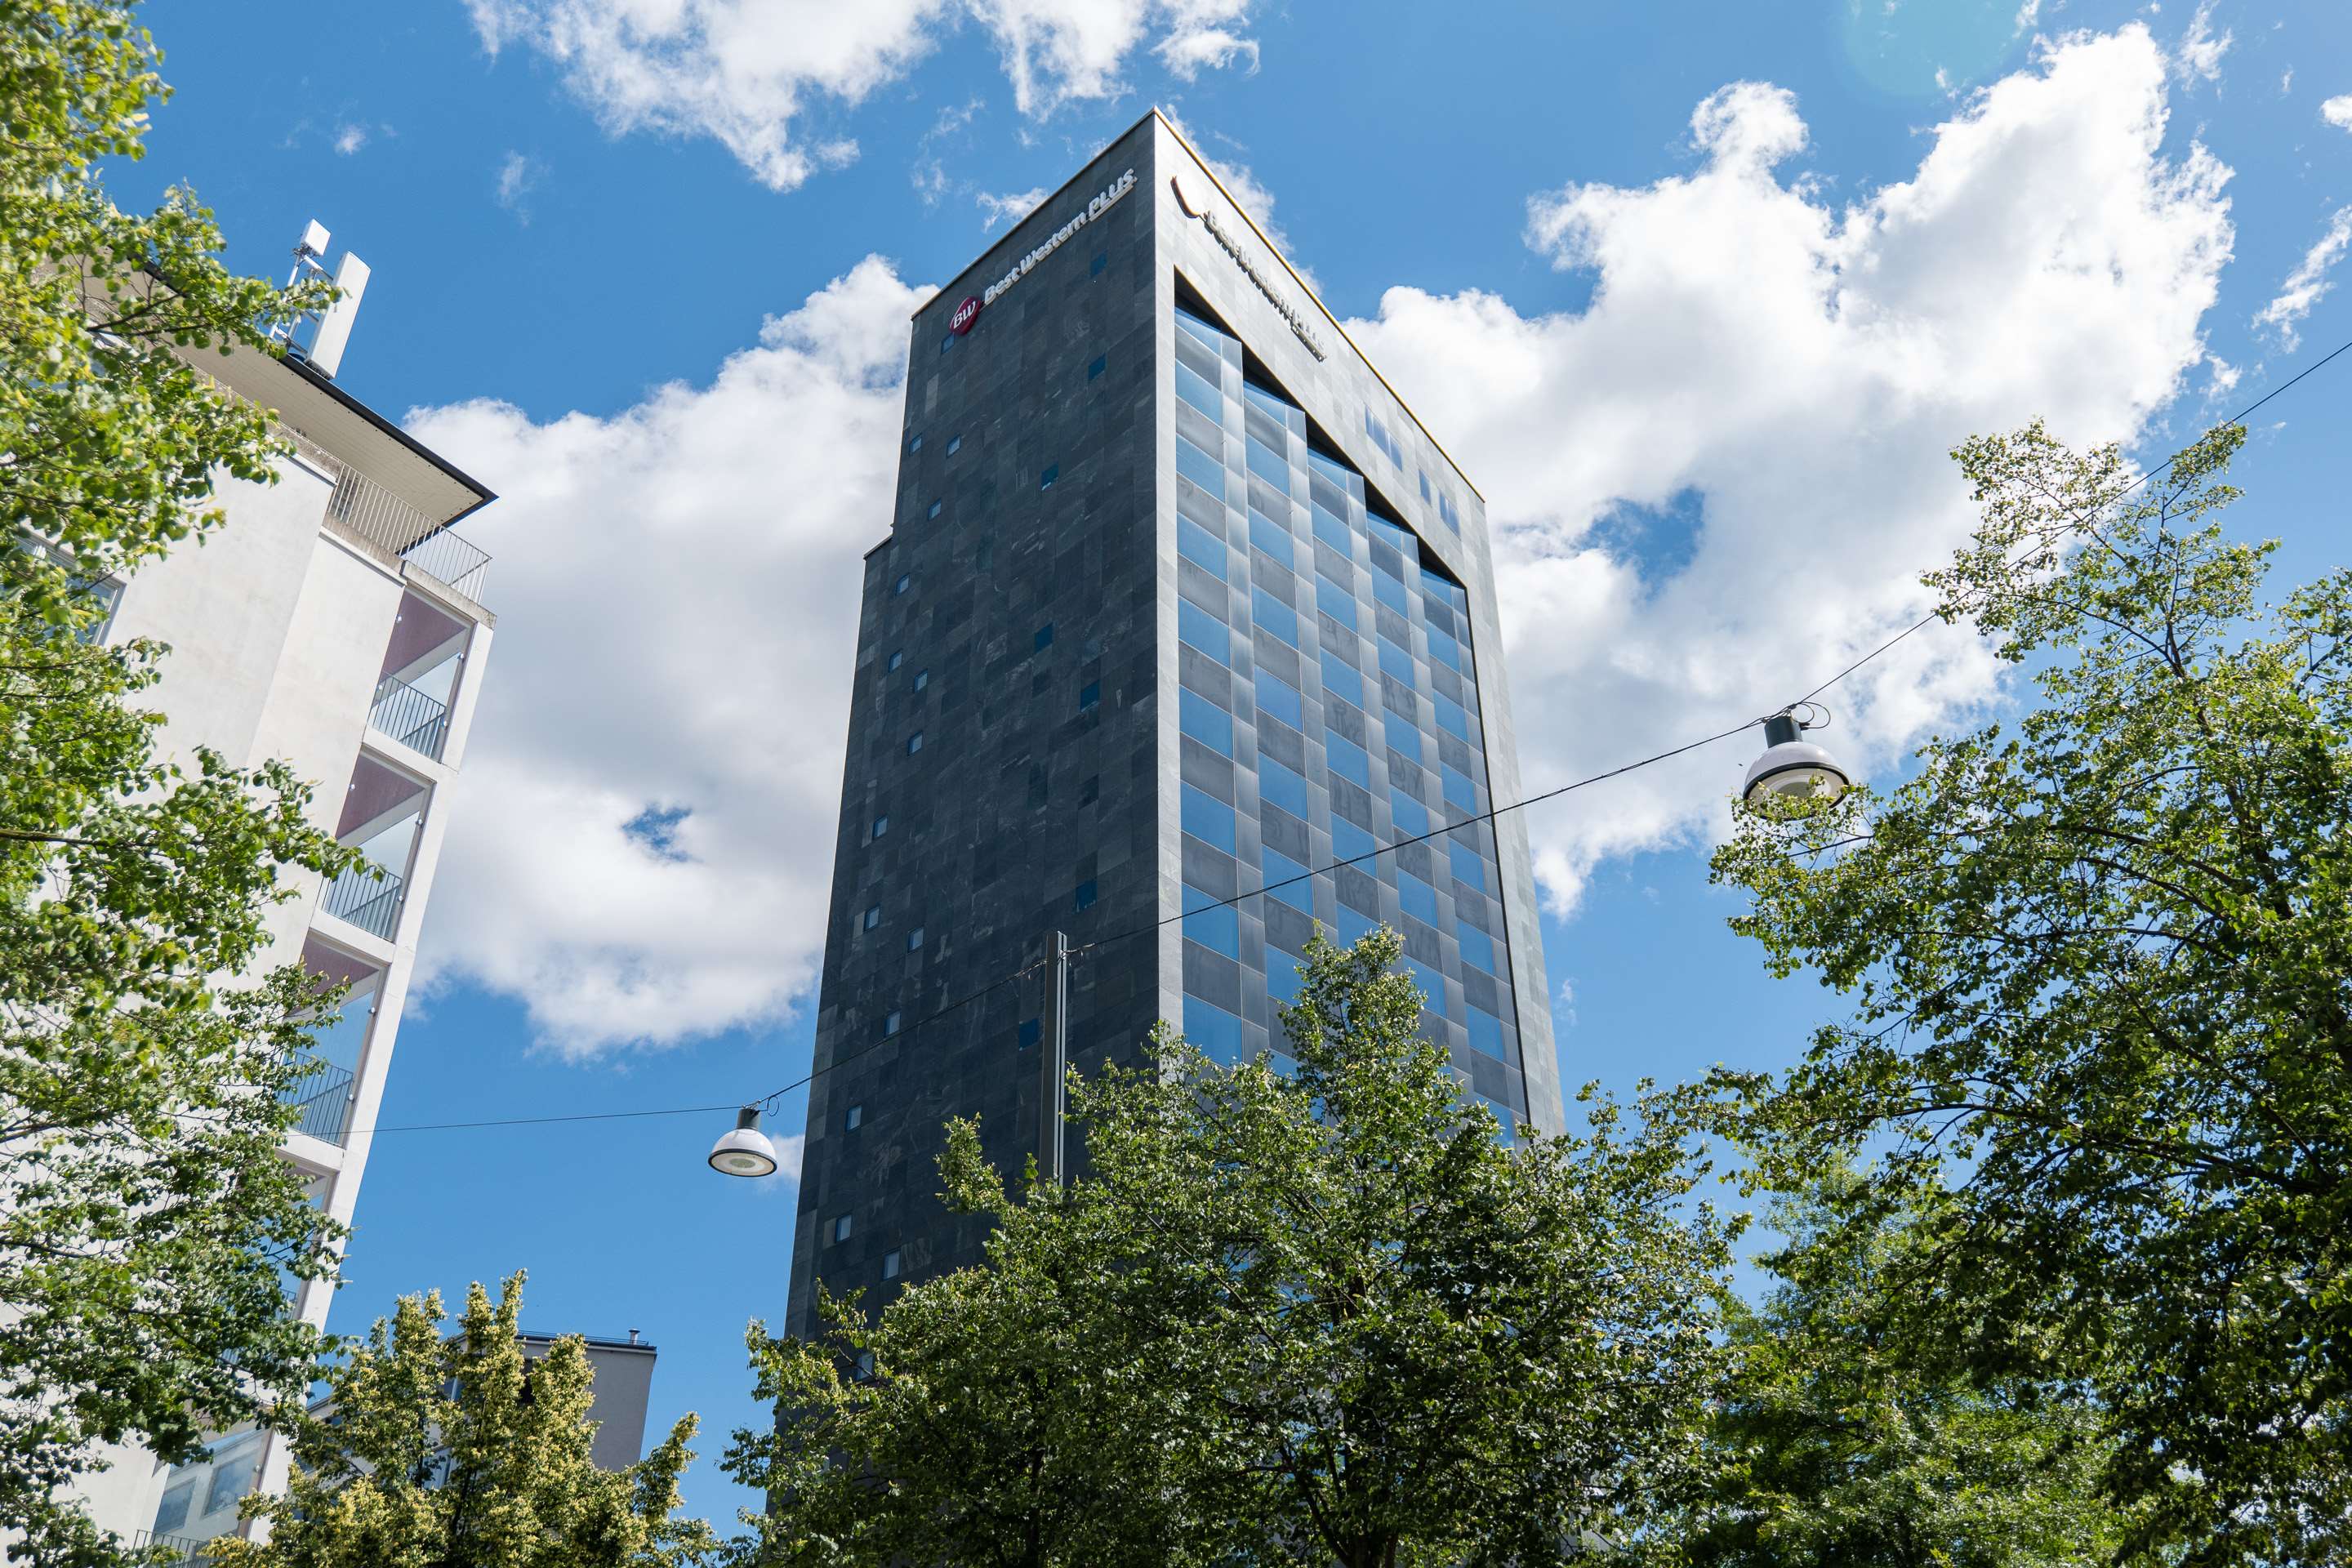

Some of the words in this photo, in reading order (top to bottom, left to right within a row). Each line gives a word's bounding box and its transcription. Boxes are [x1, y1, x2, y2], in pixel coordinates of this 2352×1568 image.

[953, 301, 976, 329] BW
[984, 266, 1020, 305] Best
[1020, 212, 1086, 274] Western
